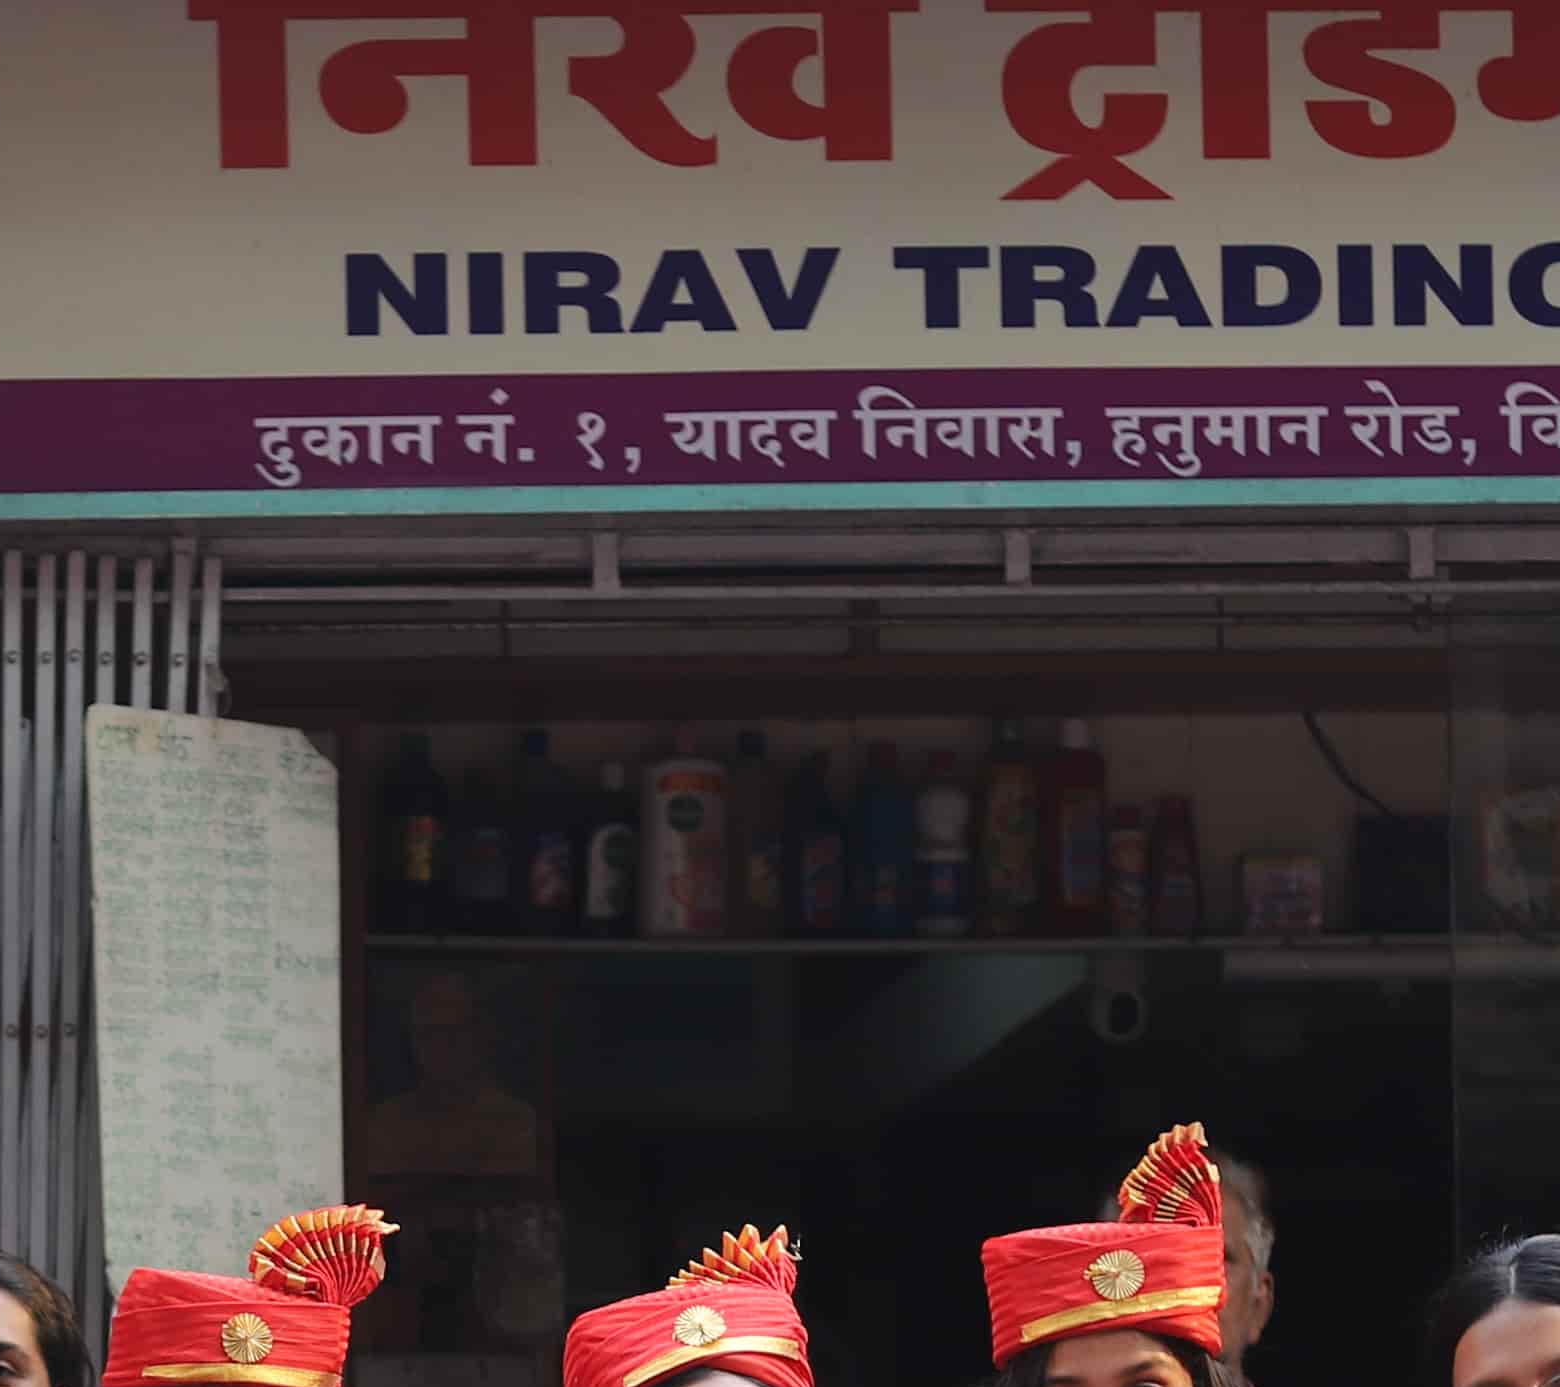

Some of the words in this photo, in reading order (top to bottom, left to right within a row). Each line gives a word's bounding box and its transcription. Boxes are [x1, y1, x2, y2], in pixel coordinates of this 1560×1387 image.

[343, 246, 841, 338] NIRAV
[255, 414, 442, 487] दुकान
[456, 388, 534, 464] नं.
[664, 410, 838, 467] यादव
[852, 386, 1082, 467] निवास,
[1105, 406, 1329, 477] हनुमान
[1343, 380, 1476, 465] रोड,
